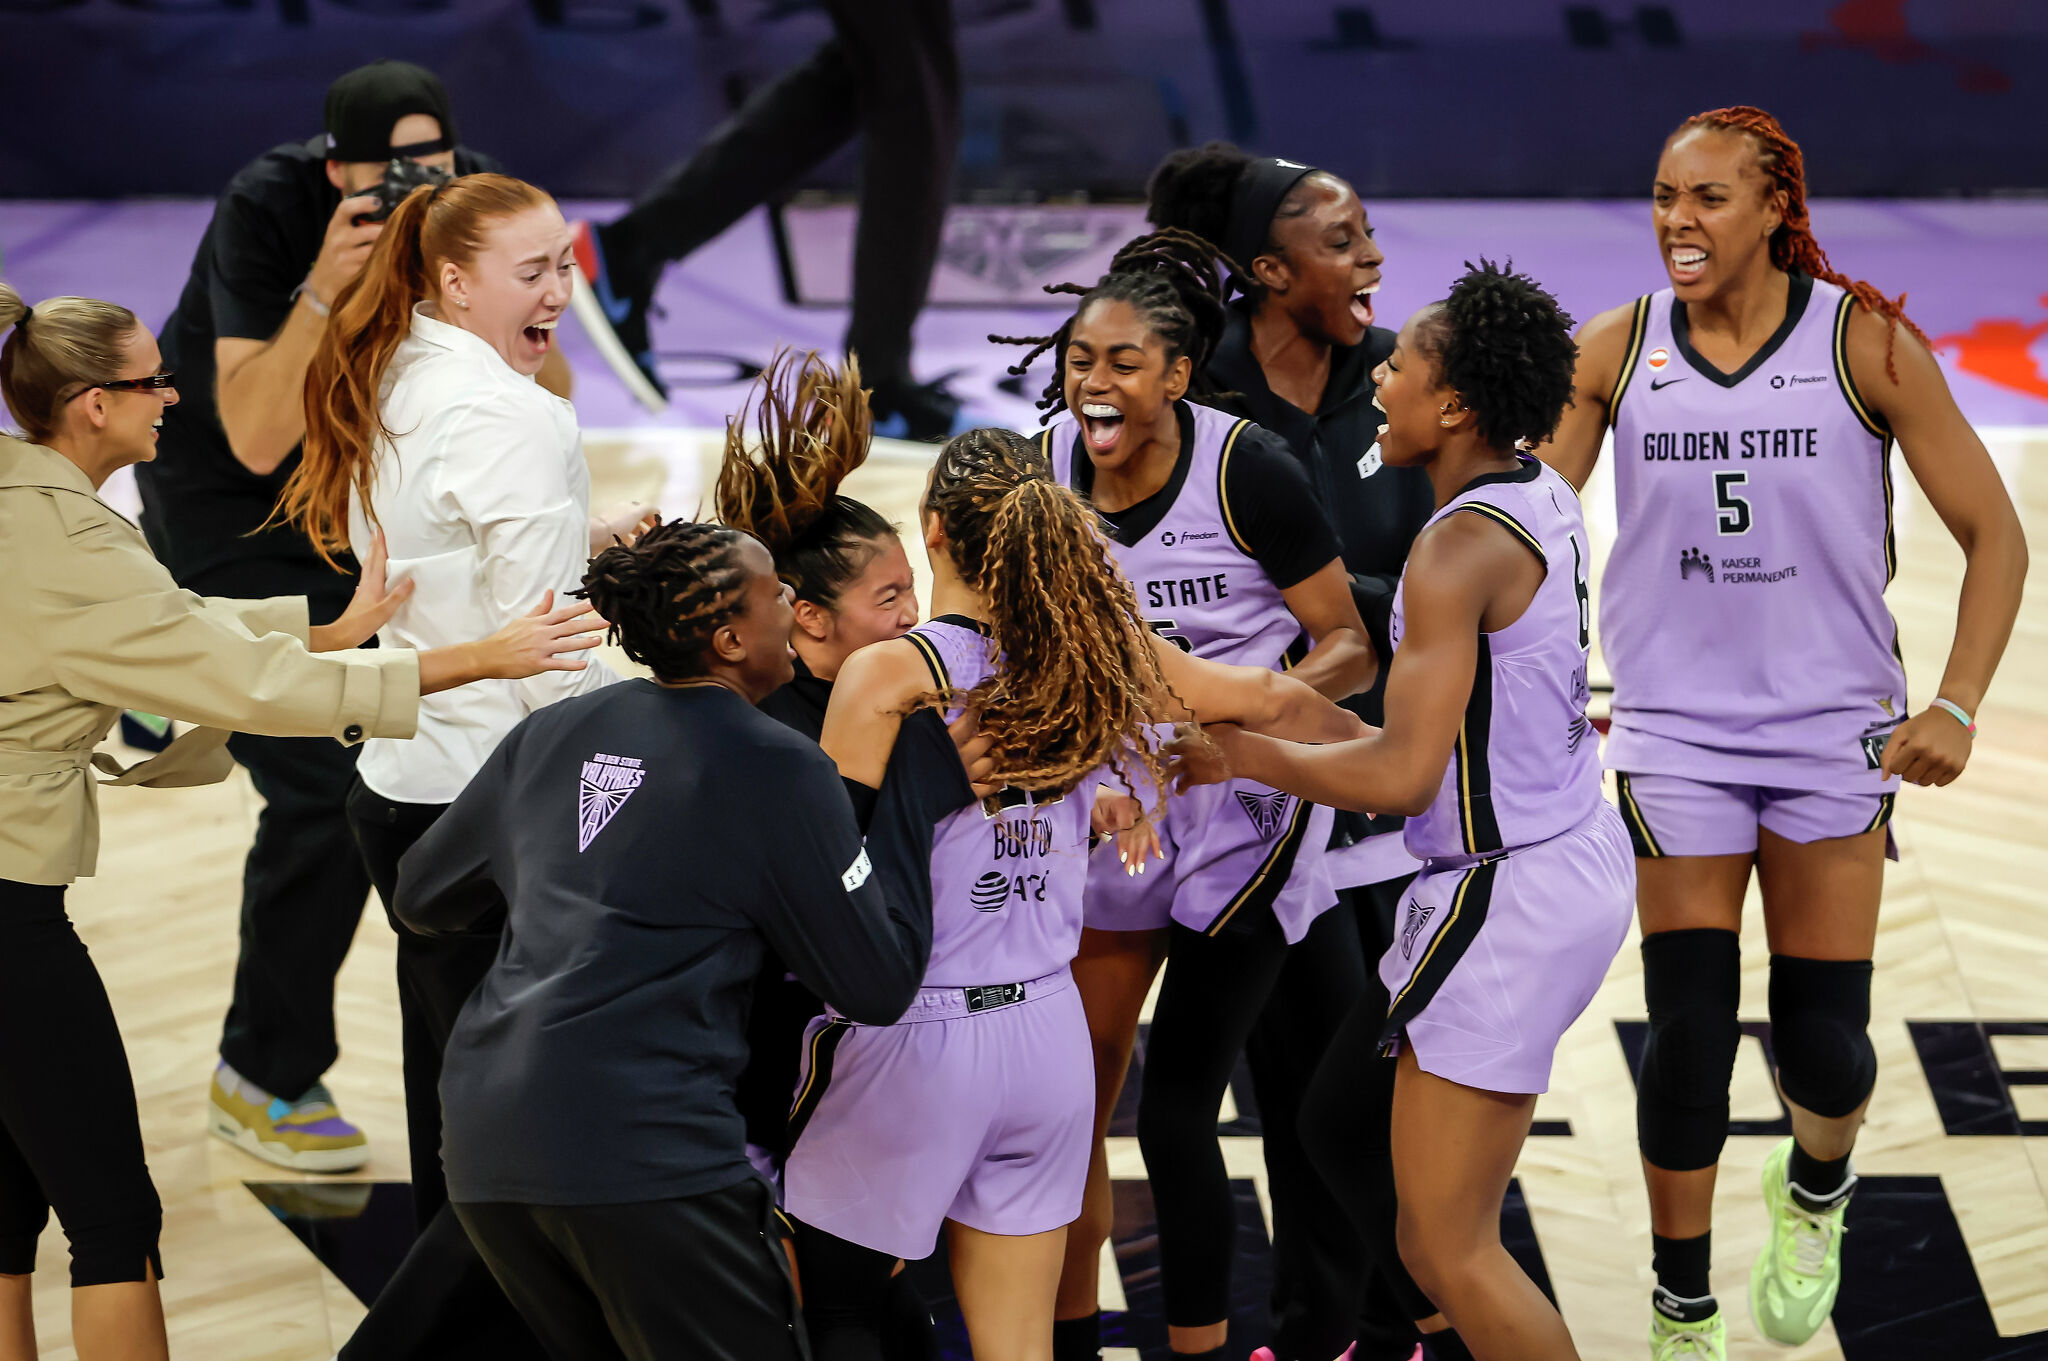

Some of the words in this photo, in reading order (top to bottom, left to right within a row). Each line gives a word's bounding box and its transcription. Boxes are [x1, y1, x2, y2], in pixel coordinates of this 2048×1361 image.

[1789, 374, 1827, 388] freedom
[1643, 432, 1730, 461] GOLDEN
[1740, 428, 1818, 459] STATE
[1712, 470, 1753, 536] 5
[1180, 531, 1219, 545] freedom
[1721, 557, 1761, 569] KAISER
[1723, 566, 1798, 584] PERMANENTE
[1146, 573, 1229, 608] STATE
